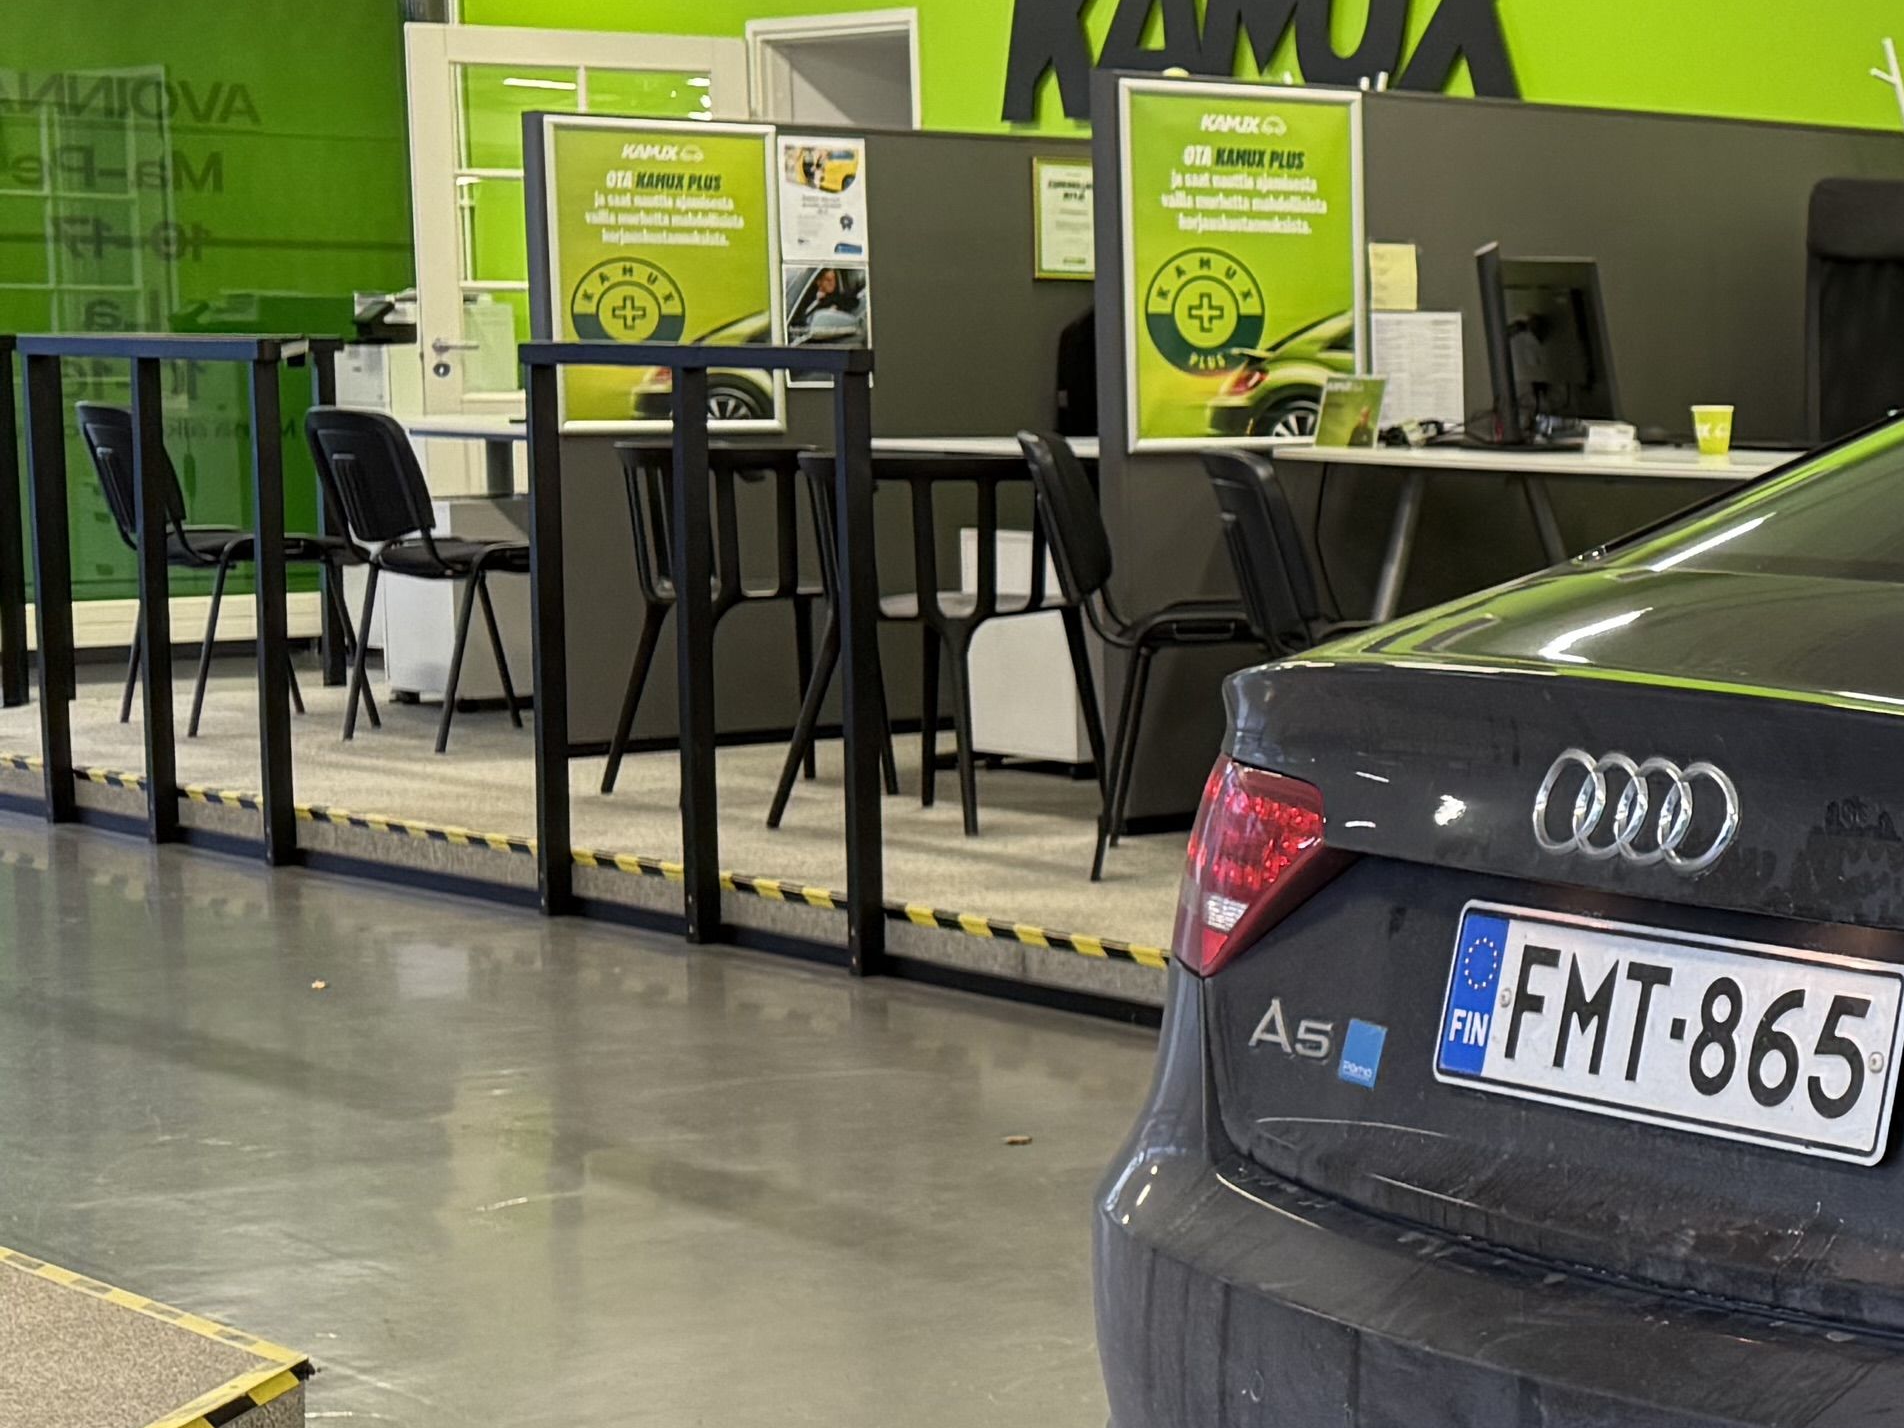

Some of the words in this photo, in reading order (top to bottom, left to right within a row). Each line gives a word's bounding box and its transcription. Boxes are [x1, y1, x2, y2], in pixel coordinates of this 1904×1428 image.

[1200, 113, 1261, 134] KAMUX
[621, 143, 678, 161] KAMUX
[1183, 145, 1212, 167] OTA
[1215, 148, 1266, 169] KAMUX
[1269, 150, 1305, 170] PLUS
[606, 170, 632, 188] OTA
[636, 171, 684, 190] KAMUX
[687, 173, 722, 191] PLUS
[582, 264, 675, 303] KAMUX
[1157, 257, 1254, 301] KAMUX
[1189, 352, 1226, 370] PLUS
[1248, 997, 1333, 1059] A5
[1449, 1009, 1490, 1047] FIN
[1504, 944, 1872, 1119] FMT-865
